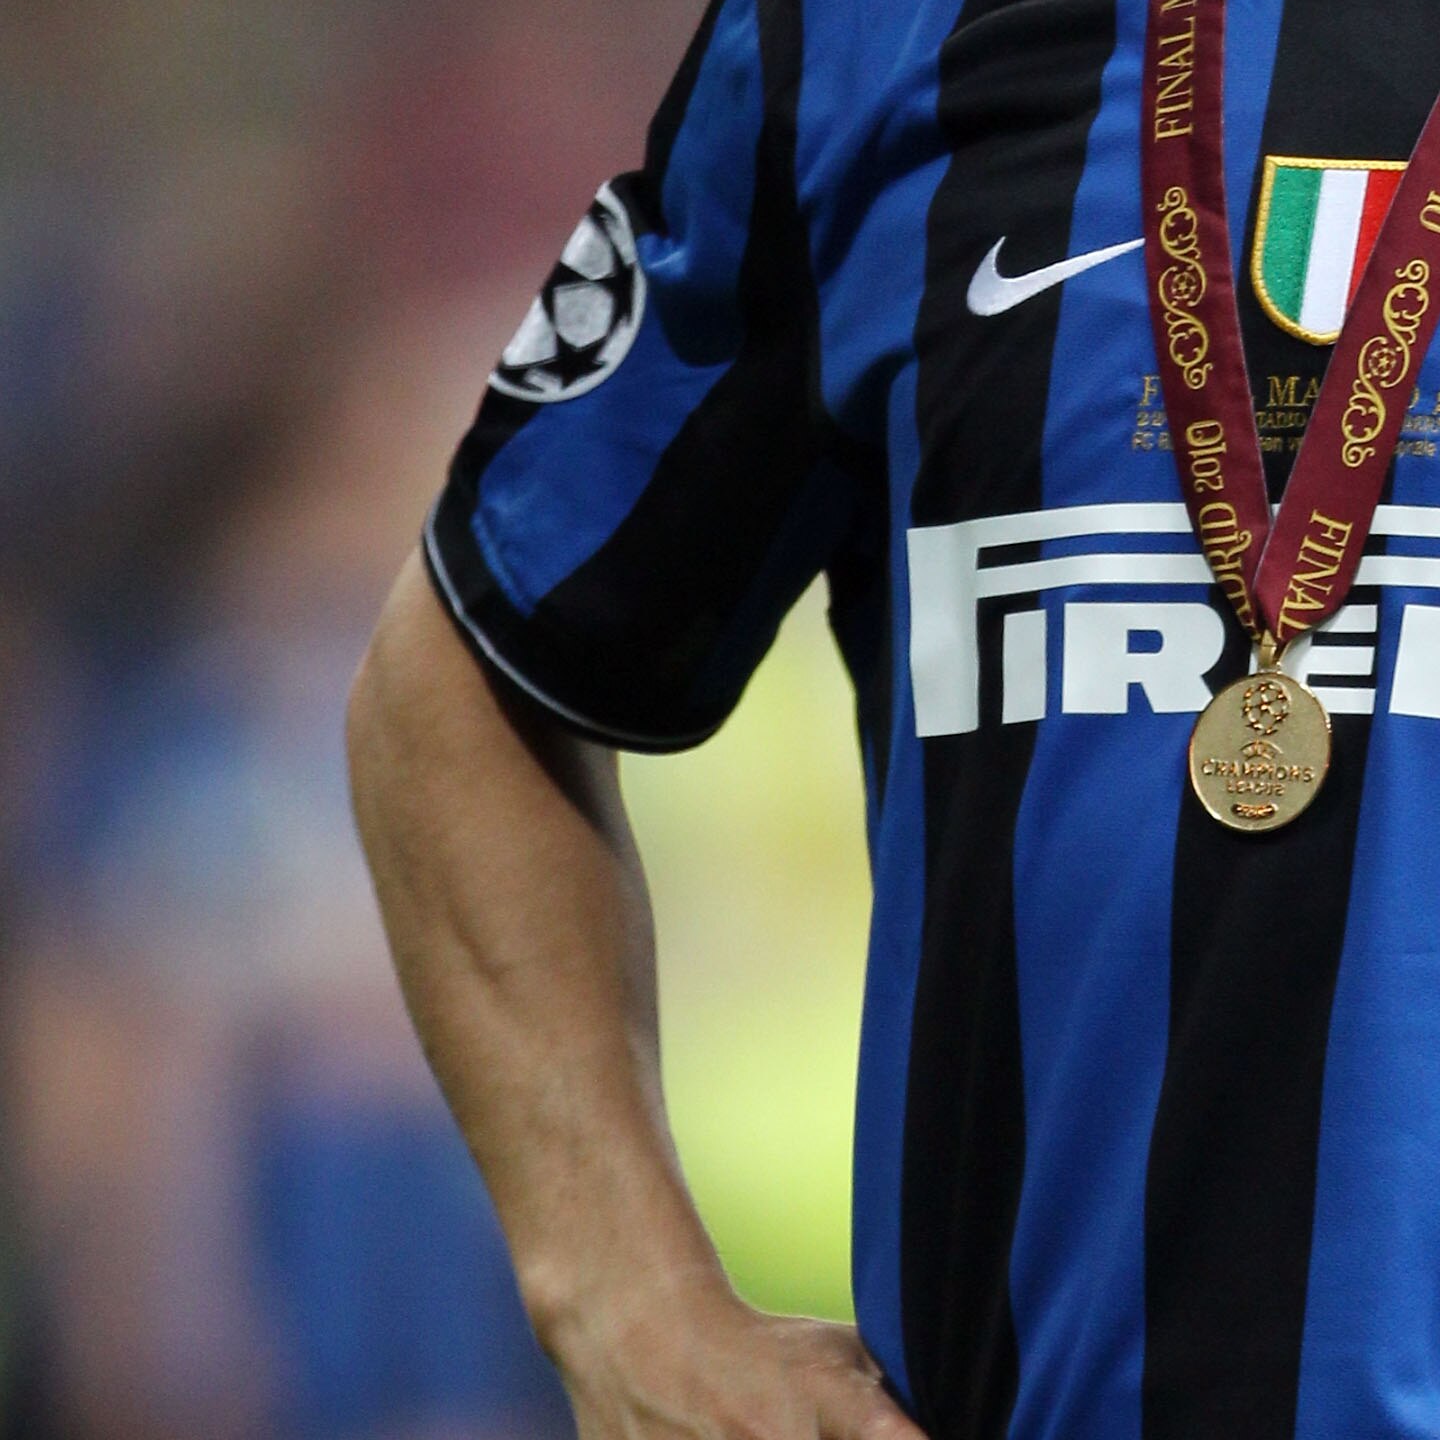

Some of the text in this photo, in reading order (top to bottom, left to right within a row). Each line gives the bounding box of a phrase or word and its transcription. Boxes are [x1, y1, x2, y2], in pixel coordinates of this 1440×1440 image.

[1154, 15, 1196, 142] FINAL
[1184, 418, 1228, 494] 2010
[1276, 509, 1354, 639] FINAL
[1201, 758, 1317, 783] CHAMPIONS
